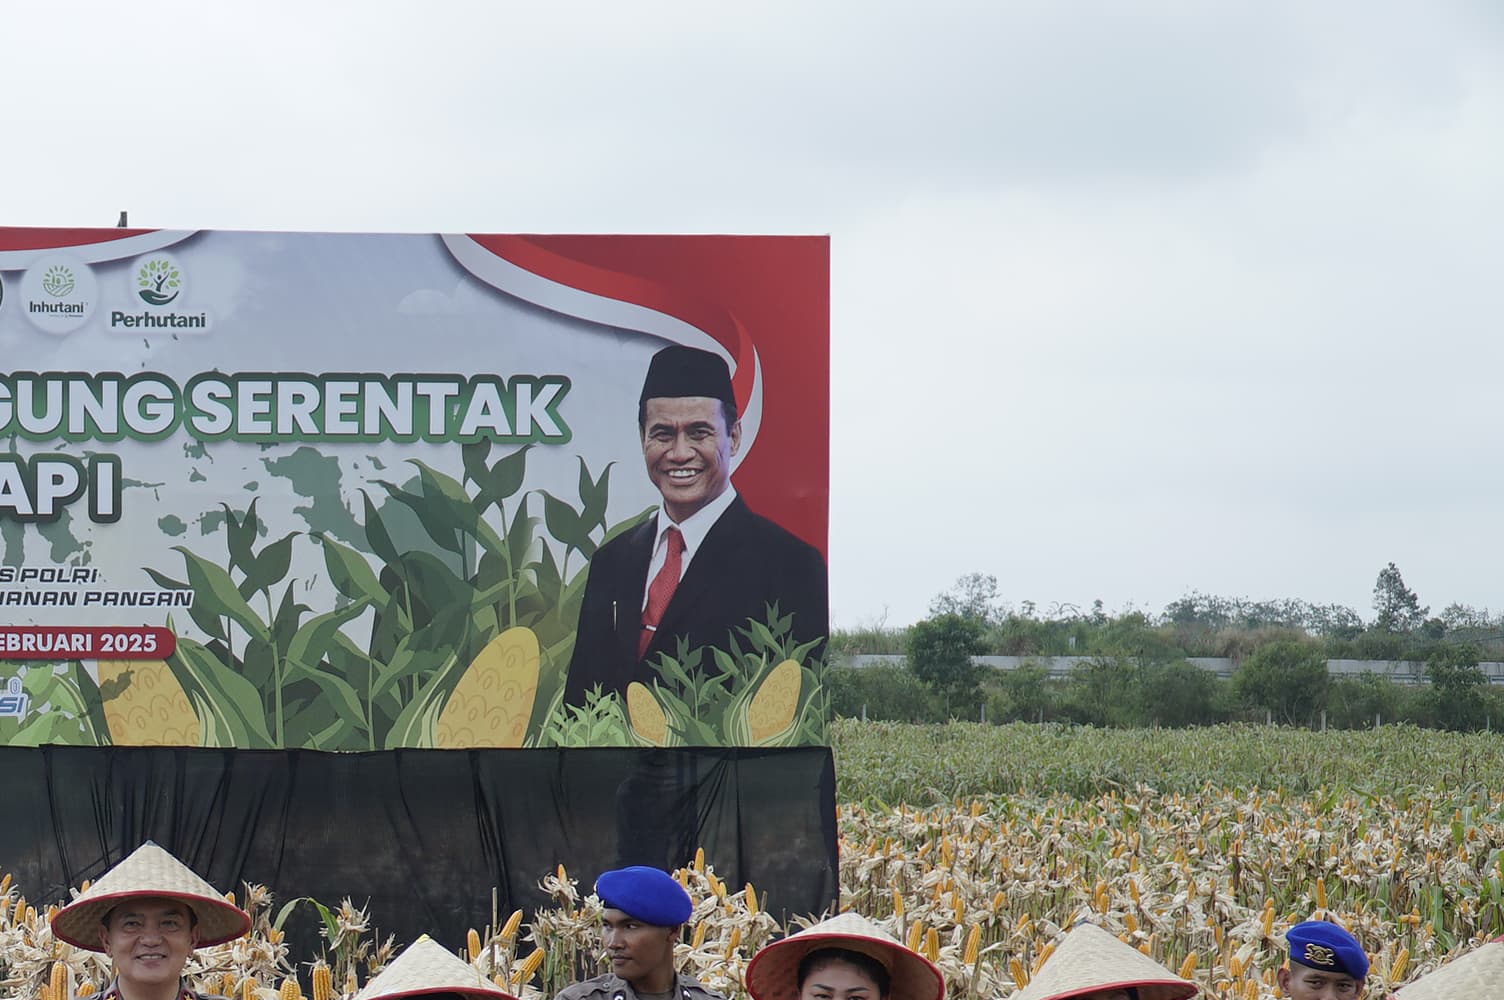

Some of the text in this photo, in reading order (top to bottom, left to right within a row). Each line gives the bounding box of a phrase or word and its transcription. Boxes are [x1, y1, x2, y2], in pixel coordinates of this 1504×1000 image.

[29, 301, 84, 313] Inhutani
[111, 311, 206, 328] Perhutani
[191, 379, 564, 437] SERENTAK
[97, 461, 114, 515] I
[20, 568, 98, 583] POLRI
[83, 591, 193, 606] PANGAN
[100, 633, 157, 652] 2025
